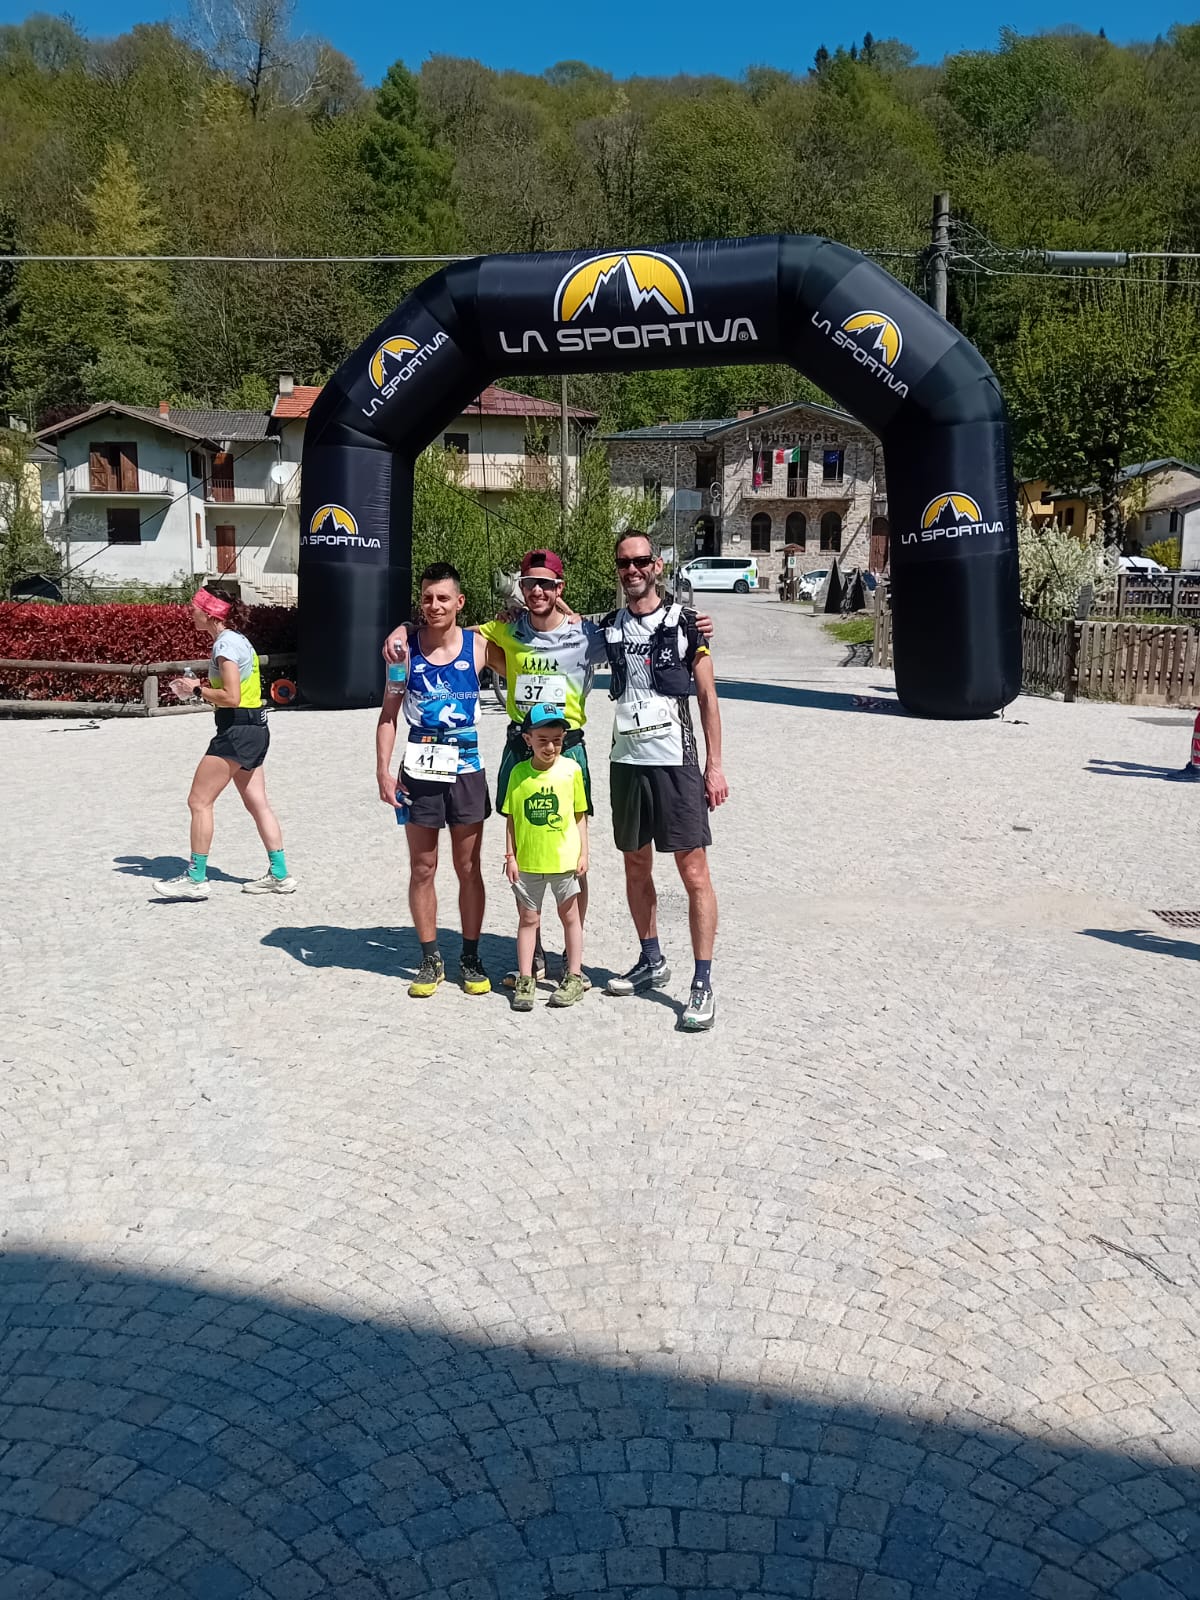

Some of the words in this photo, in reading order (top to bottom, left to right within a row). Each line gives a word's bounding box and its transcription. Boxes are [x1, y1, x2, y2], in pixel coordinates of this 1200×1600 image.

[499, 330, 549, 353] LA
[556, 317, 758, 351] SPORTIVA
[811, 311, 832, 335] LA
[831, 330, 909, 399] SPORTIVA
[362, 398, 384, 417] LA
[381, 331, 449, 400] SPORTIVA
[901, 533, 918, 544] LA
[921, 521, 1004, 542] SPORTIVA
[309, 535, 381, 549] SPORTIVA
[524, 685, 544, 701] 37
[632, 712, 640, 727] 1
[415, 754, 434, 769] 41
[528, 798, 553, 810] MZS
